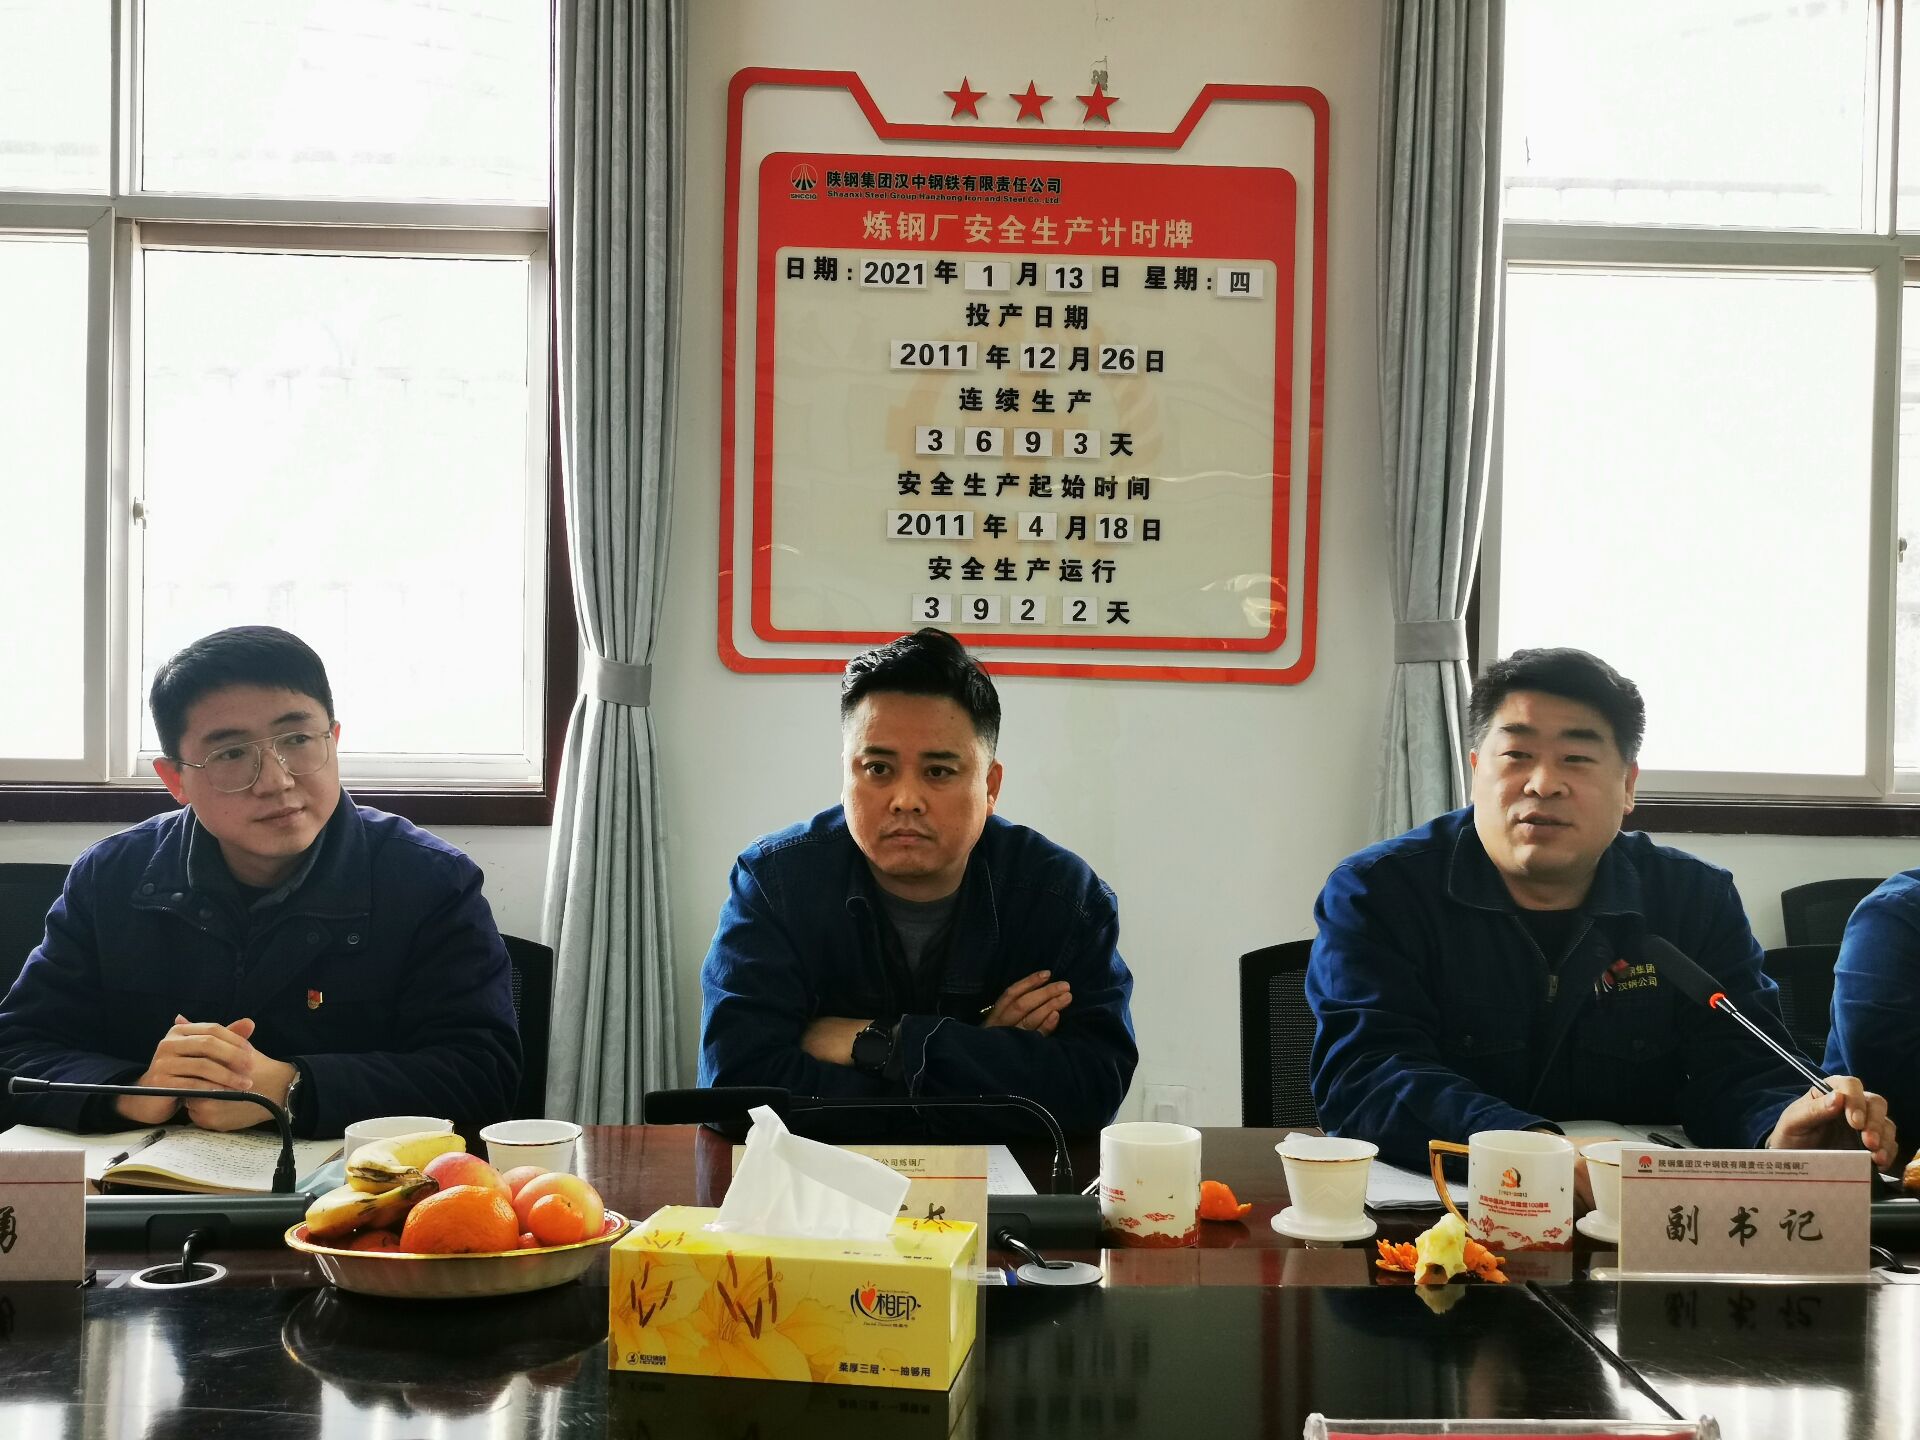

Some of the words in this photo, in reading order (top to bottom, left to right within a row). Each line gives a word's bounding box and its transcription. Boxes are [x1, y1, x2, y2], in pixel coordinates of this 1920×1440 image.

[826, 171, 1062, 194] 陕钢集团汉中钢铁有限责任公司
[828, 190, 862, 198] Shaanxi
[864, 191, 887, 199] Steel
[890, 192, 917, 201] Group
[919, 193, 963, 201] Hanzhong
[1003, 195, 1025, 203] Steel
[863, 210, 1194, 249] 炼钢厂安全生产计时牌
[966, 303, 1088, 330] 投产日期
[959, 387, 1092, 413] 连续生产
[897, 471, 1151, 500] 安全生产起始时间
[928, 556, 1117, 583] 安全生产运行
[874, 1158, 926, 1167] 公司炼钢厂
[1666, 1204, 1824, 1247] 副书记
